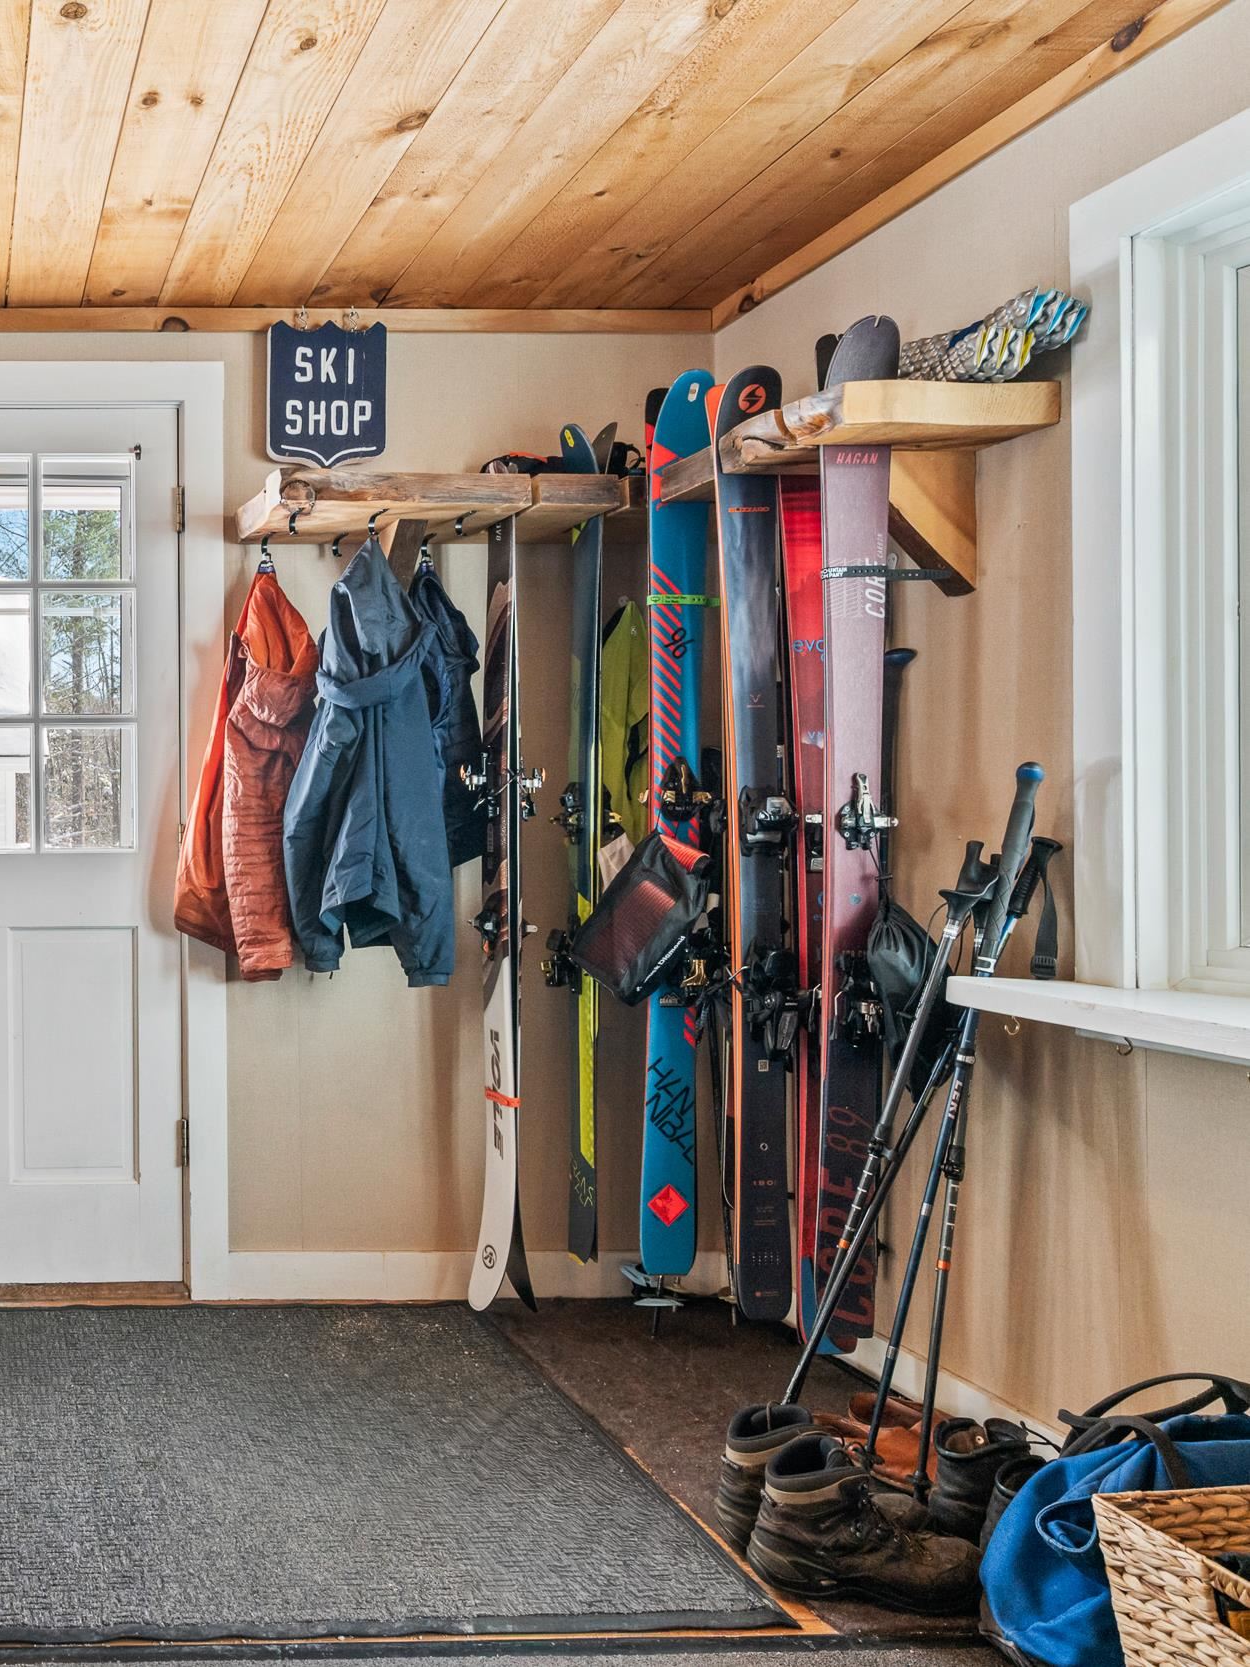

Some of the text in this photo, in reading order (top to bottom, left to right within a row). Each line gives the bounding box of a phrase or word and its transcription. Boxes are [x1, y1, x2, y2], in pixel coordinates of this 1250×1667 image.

[294, 346, 355, 385] SKI
[285, 399, 372, 436] SHOP
[836, 452, 879, 465] HAGAN
[657, 935, 686, 966] Diamond
[948, 1080, 963, 1120] LEKI
